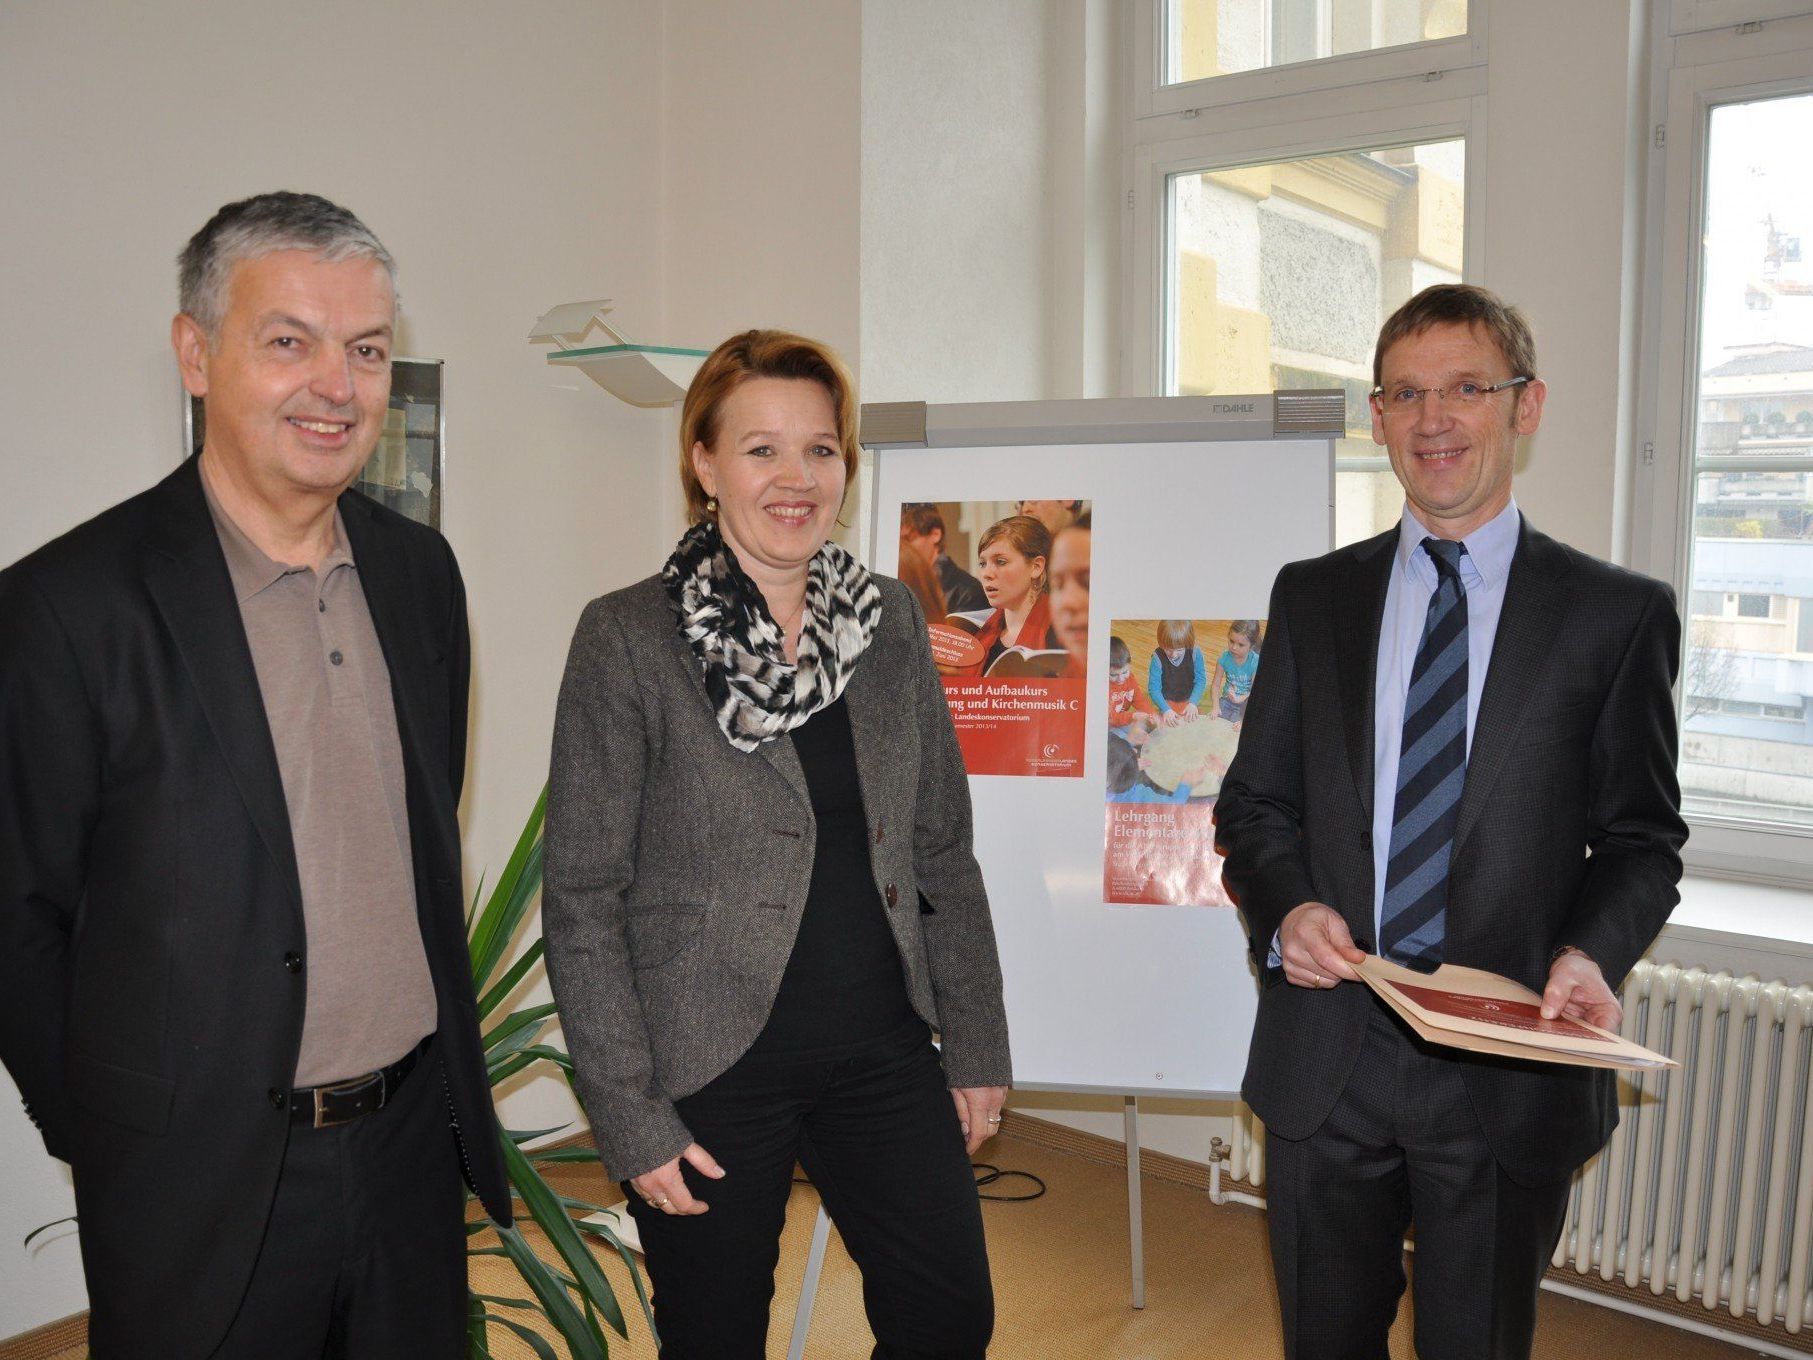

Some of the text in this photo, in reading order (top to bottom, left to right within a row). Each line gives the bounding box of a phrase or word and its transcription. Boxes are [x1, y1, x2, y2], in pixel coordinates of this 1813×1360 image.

[1222, 404, 1254, 413] DAHLE
[961, 684, 982, 695] und
[985, 684, 1048, 696] Aufbaukurs
[967, 699, 988, 709] und
[991, 699, 1066, 710] Kirchenmusik
[1069, 699, 1079, 710] C
[954, 713, 1030, 721] Landeskonservatorium
[1114, 810, 1175, 826] Lehrgang
